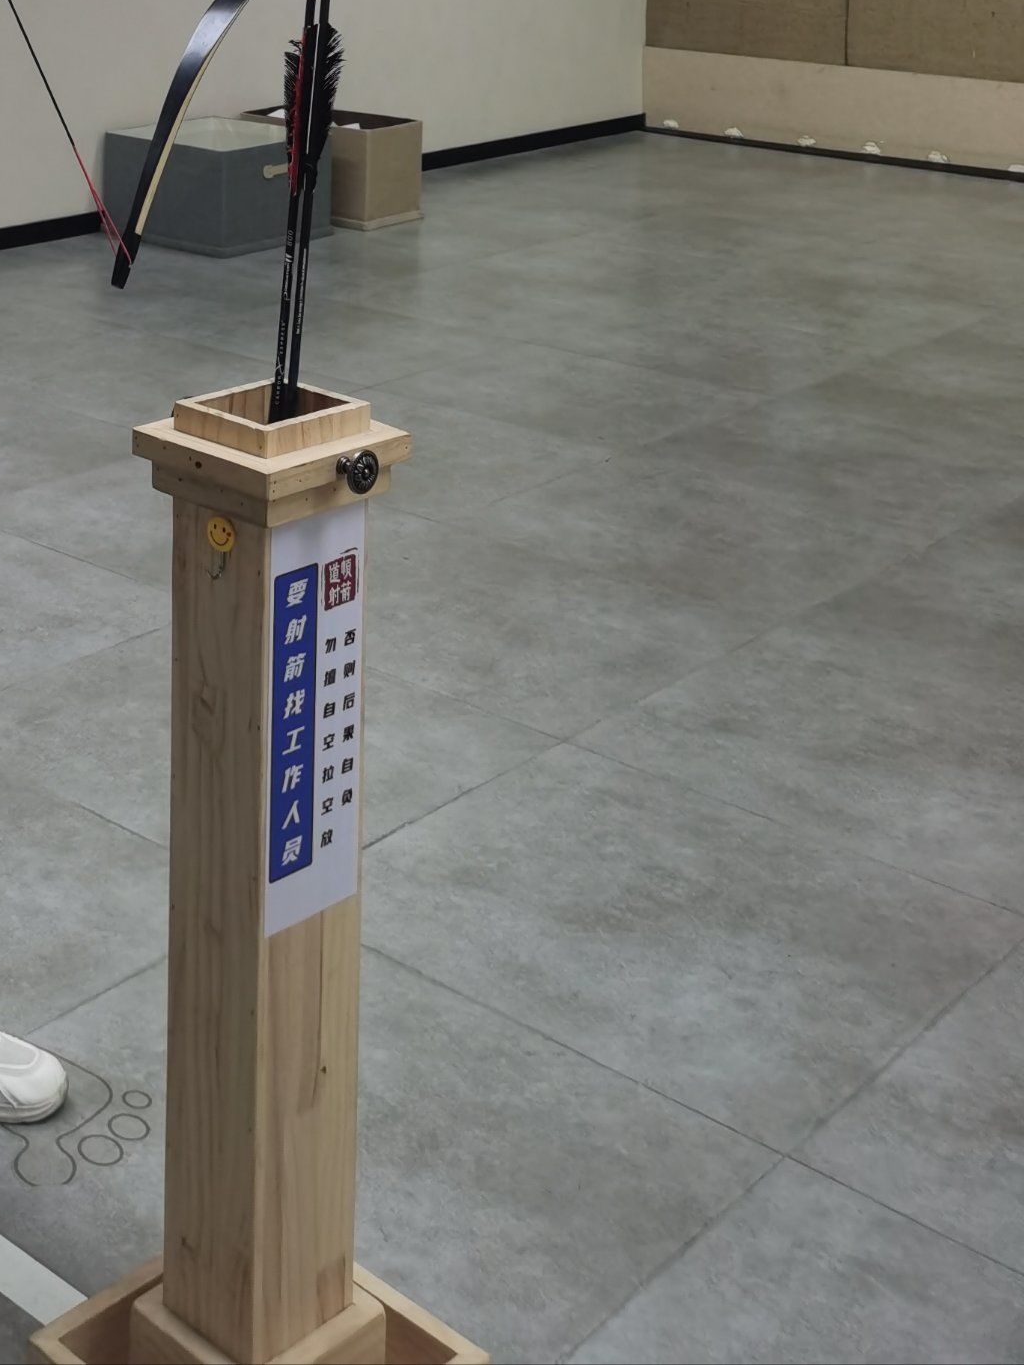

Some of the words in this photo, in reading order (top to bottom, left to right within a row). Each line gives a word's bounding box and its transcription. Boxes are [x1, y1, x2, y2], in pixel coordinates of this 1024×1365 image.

[282, 578, 308, 867] 要射箭找工作人员
[320, 636, 337, 849] 勿擅自空拉空放
[341, 628, 357, 806] 否则后果自负
